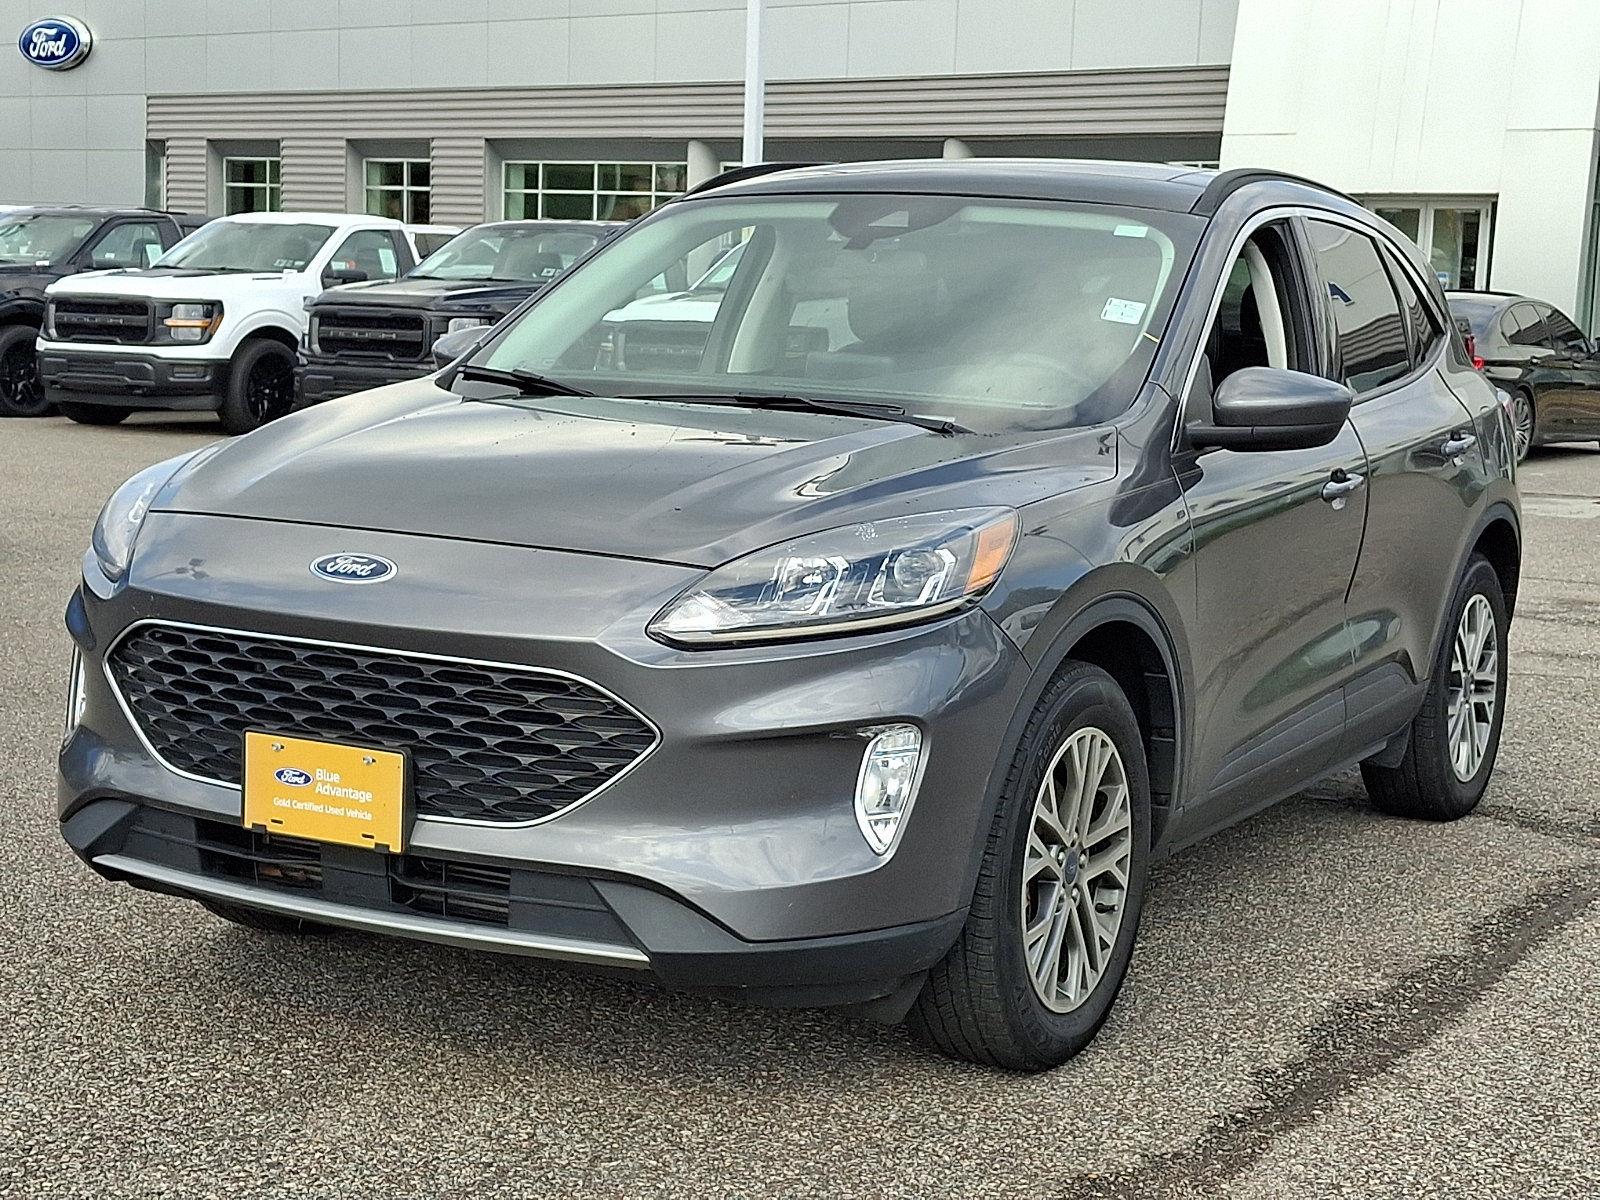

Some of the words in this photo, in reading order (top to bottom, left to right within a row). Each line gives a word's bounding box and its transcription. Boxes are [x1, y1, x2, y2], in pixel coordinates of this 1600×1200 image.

[29, 27, 67, 58] Ford
[326, 555, 377, 576] Ford
[281, 770, 306, 784] Ford
[315, 768, 341, 783] Blue
[315, 782, 373, 802] Advantage
[273, 796, 291, 807] Gold
[292, 799, 324, 813] Certified
[325, 804, 344, 816] Used
[345, 807, 373, 821] Vehicle
